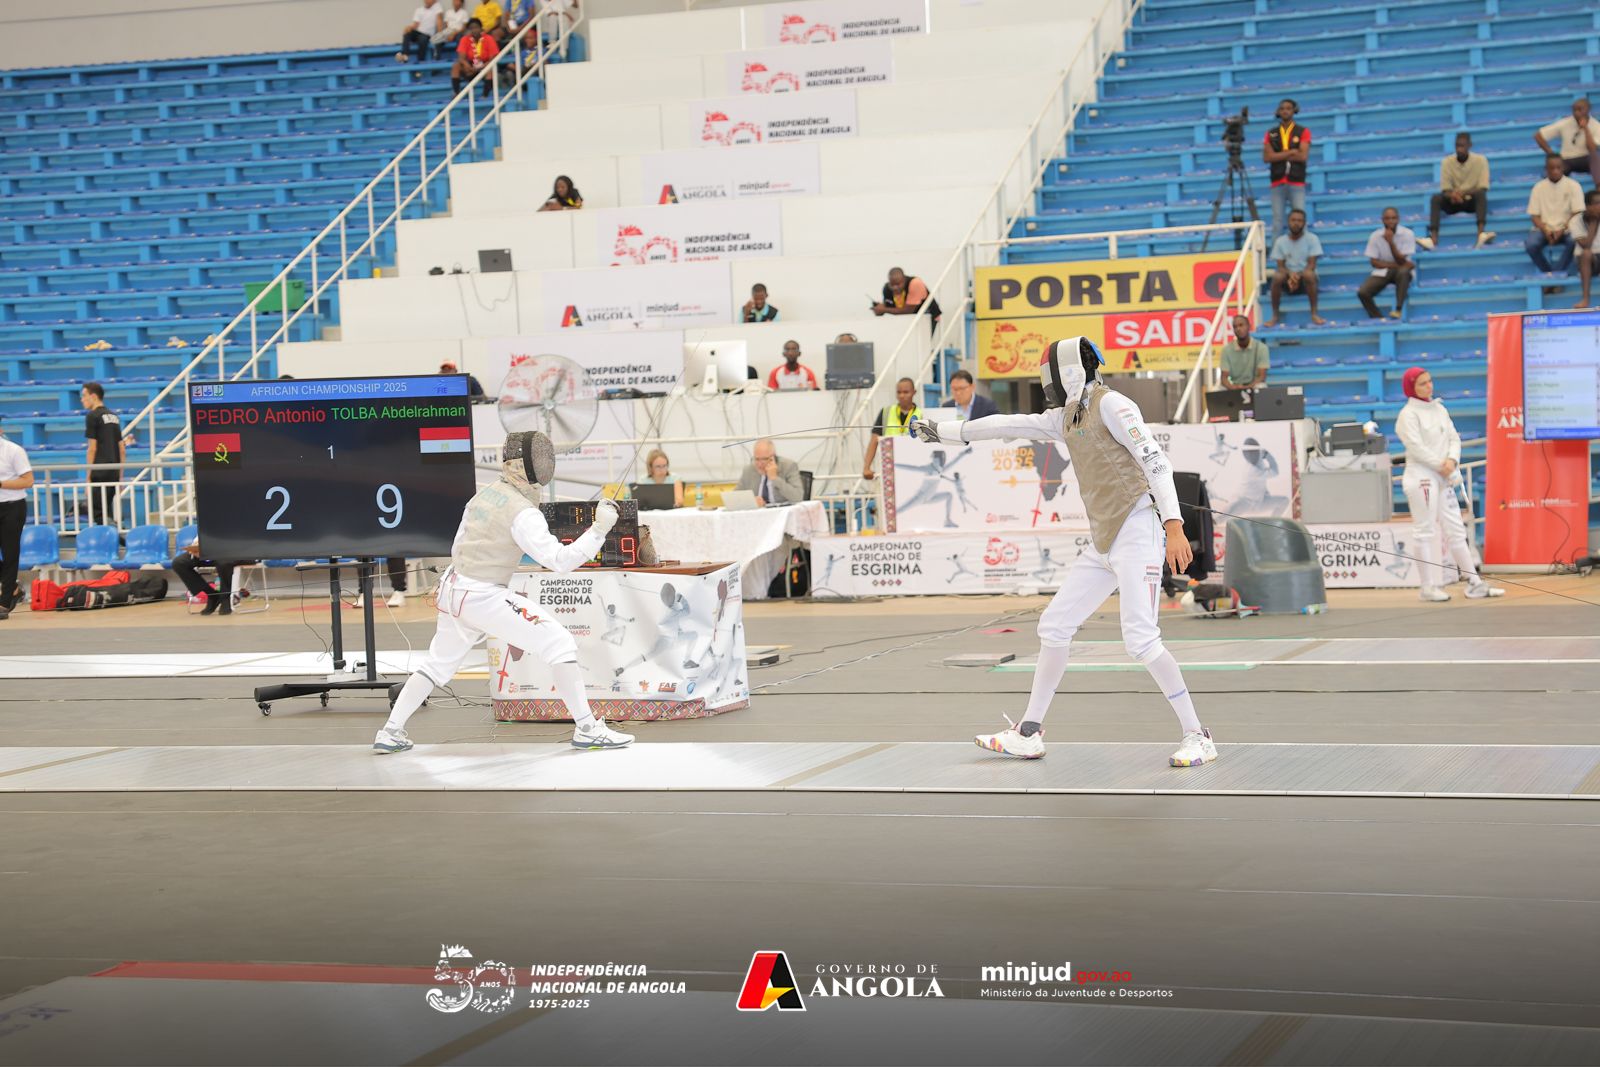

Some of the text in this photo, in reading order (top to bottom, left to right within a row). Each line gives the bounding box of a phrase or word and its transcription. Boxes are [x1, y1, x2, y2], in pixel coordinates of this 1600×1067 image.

[684, 232, 751, 245] INDEPENDÊNCIA
[684, 243, 726, 255] NACIONAL
[740, 242, 773, 251] ANGOLA
[988, 270, 1178, 311] PORTA
[585, 311, 634, 323] ANGOLA
[1115, 311, 1240, 347] SAÍDA
[628, 375, 640, 385] DE
[642, 374, 677, 384] ANGOLA
[250, 381, 407, 397] AFRICAIN CHAMPIONSHIP 2025
[195, 406, 327, 426] PEDRO Antonio
[330, 404, 466, 420] TOLBA Abdelrahman
[327, 444, 334, 460] 1
[992, 457, 1035, 471] 2025
[264, 483, 404, 530] 2 9
[1315, 531, 1381, 541] MPEONATO
[621, 537, 636, 565] 9
[849, 541, 922, 552] CAMPEONATO
[1315, 542, 1381, 553] RICANO DE
[851, 552, 921, 562] AFRICANO DE
[1321, 554, 1381, 567] GRIMA
[851, 563, 923, 576] ESGRIMA
[540, 579, 593, 587] CAMPEONATO
[540, 587, 593, 595] AFRICANO DE
[539, 595, 593, 606] ESGRIMA
